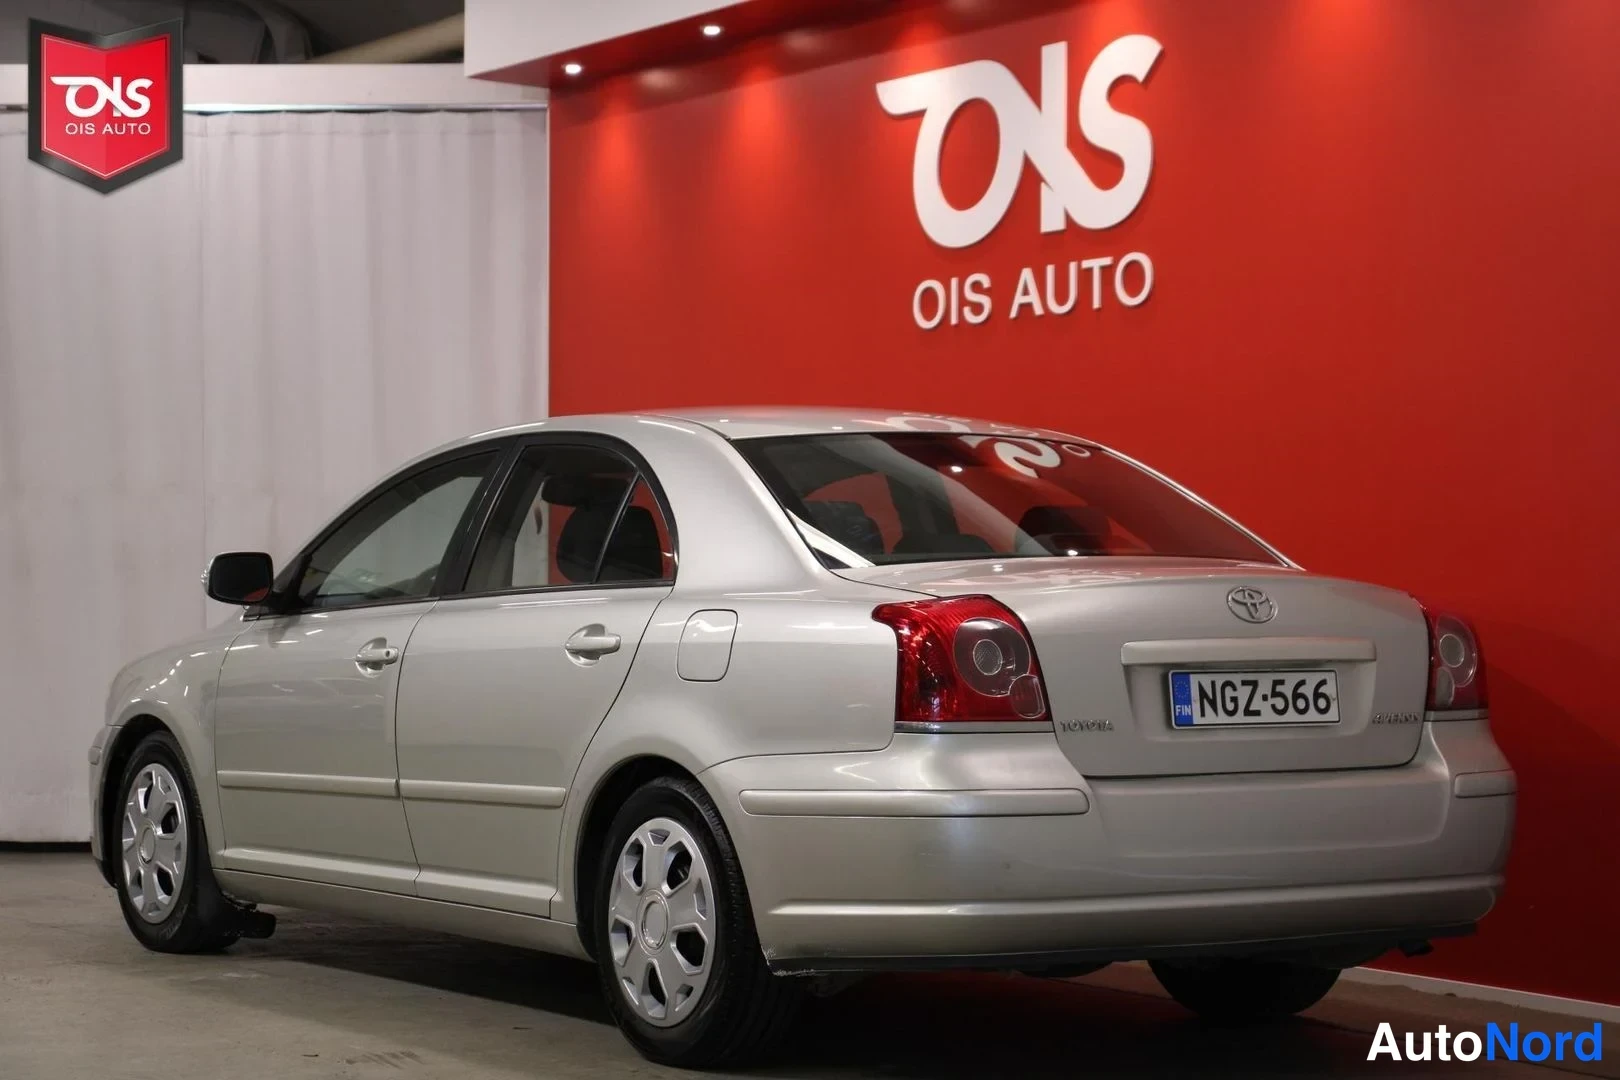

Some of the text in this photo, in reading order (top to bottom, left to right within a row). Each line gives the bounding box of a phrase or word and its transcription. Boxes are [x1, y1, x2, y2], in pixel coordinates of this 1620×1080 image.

[912, 251, 1154, 330] OIS AUTO
[1175, 704, 1192, 717] FIN
[1060, 719, 1114, 732] TOYOTA
